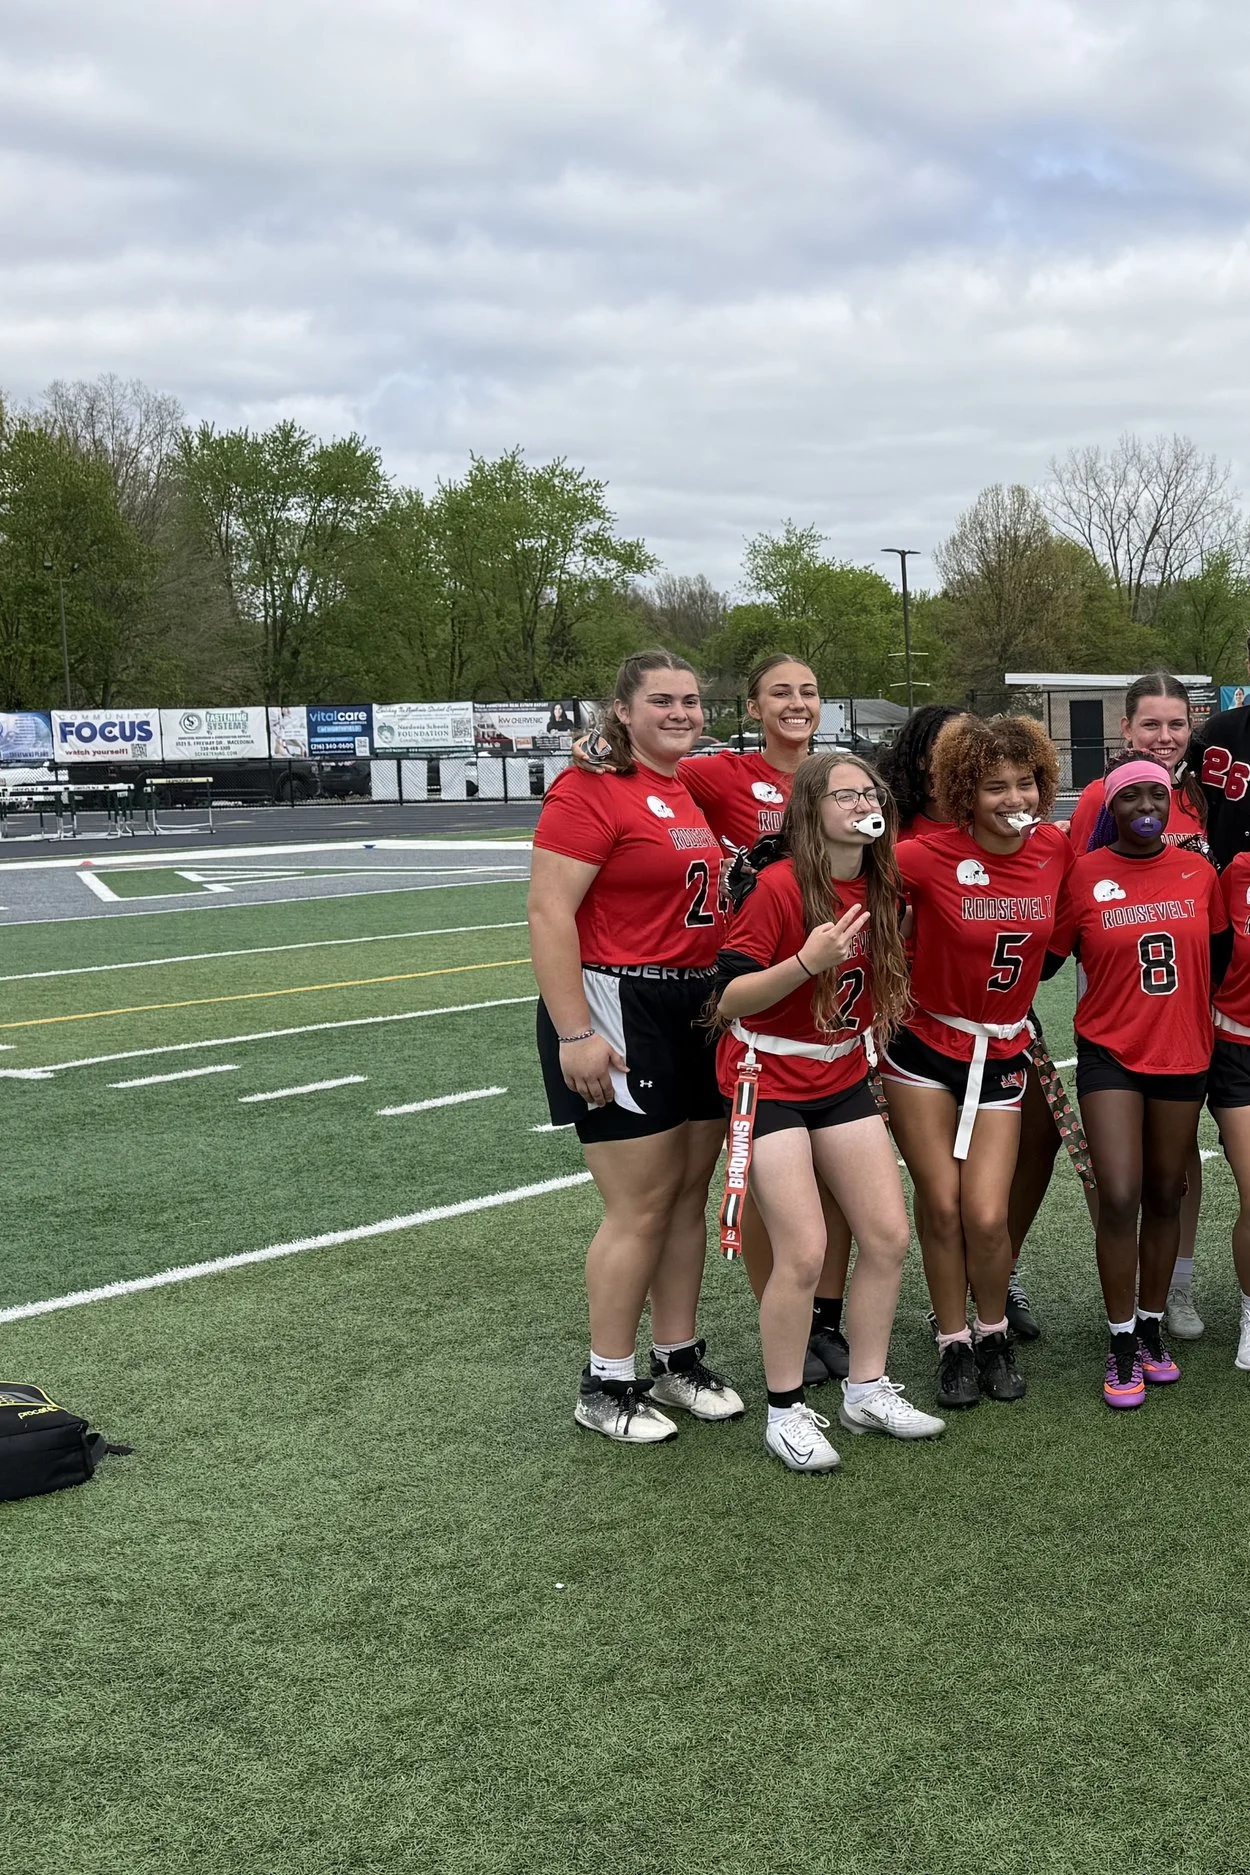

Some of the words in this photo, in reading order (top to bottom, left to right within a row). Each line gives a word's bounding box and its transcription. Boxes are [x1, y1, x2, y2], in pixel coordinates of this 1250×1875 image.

[59, 712, 151, 721] COMMUNITY
[207, 722, 248, 731] SYSTEMS
[309, 710, 368, 722] vitalcare
[59, 720, 153, 744] FOCUS
[65, 748, 91, 756] watch
[962, 895, 1052, 921] ROOSEVELT
[1101, 899, 1195, 930] ROOSEVELT
[986, 932, 1034, 993] 5
[1137, 931, 1178, 996] 8
[728, 1119, 751, 1189] BROWNS
